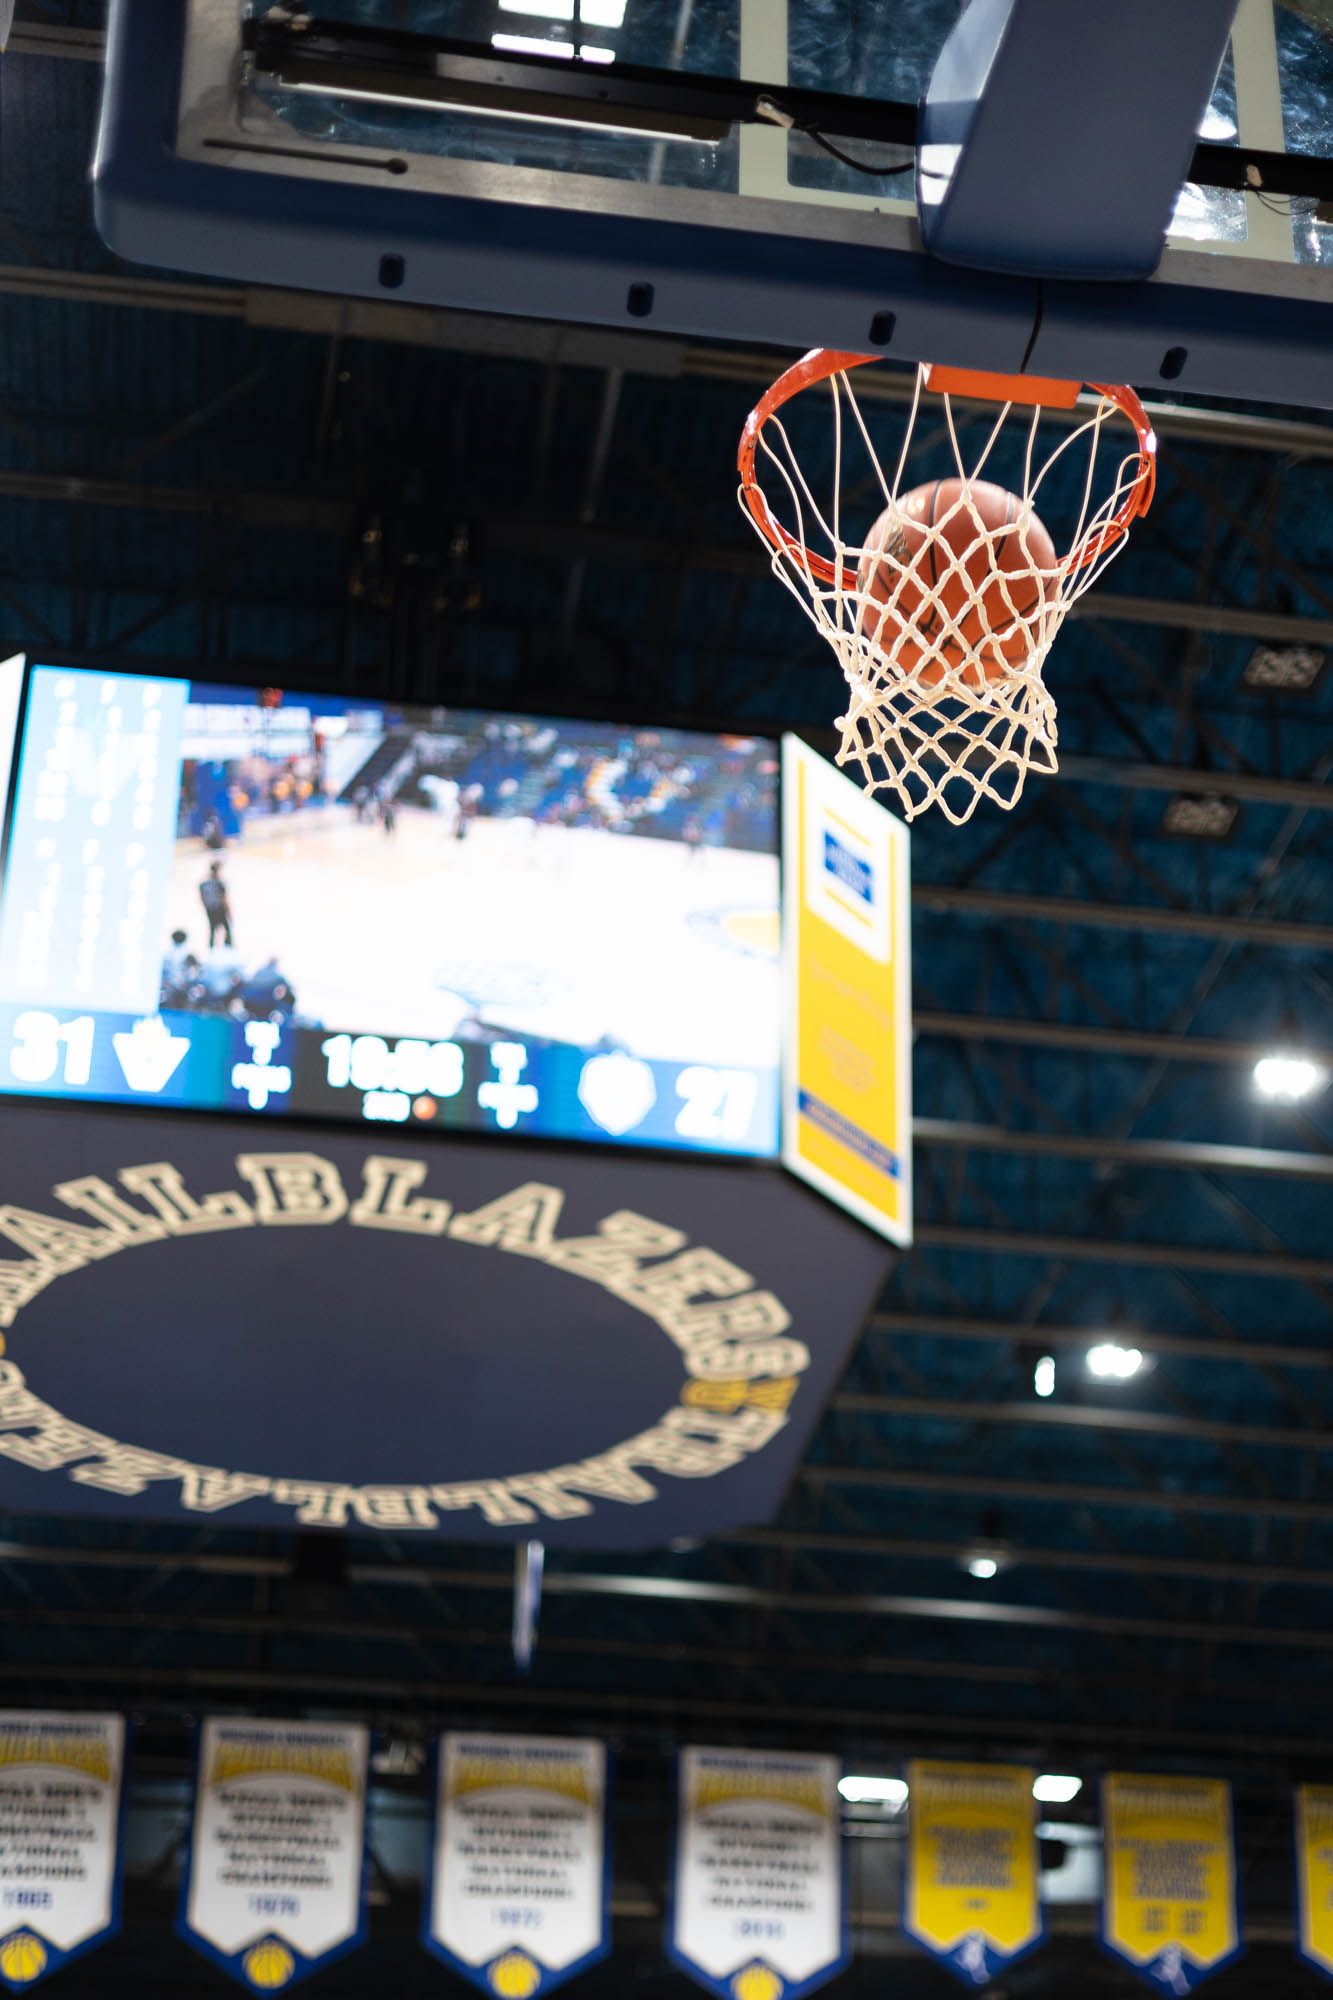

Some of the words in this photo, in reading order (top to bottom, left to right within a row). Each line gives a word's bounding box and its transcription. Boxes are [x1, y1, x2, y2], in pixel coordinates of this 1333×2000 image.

[9, 1010, 95, 1085] 31
[675, 1065, 758, 1140] 27
[0, 1151, 811, 1381] AILBLAZERS
[0, 1358, 789, 1530] TRAILBLAZE
